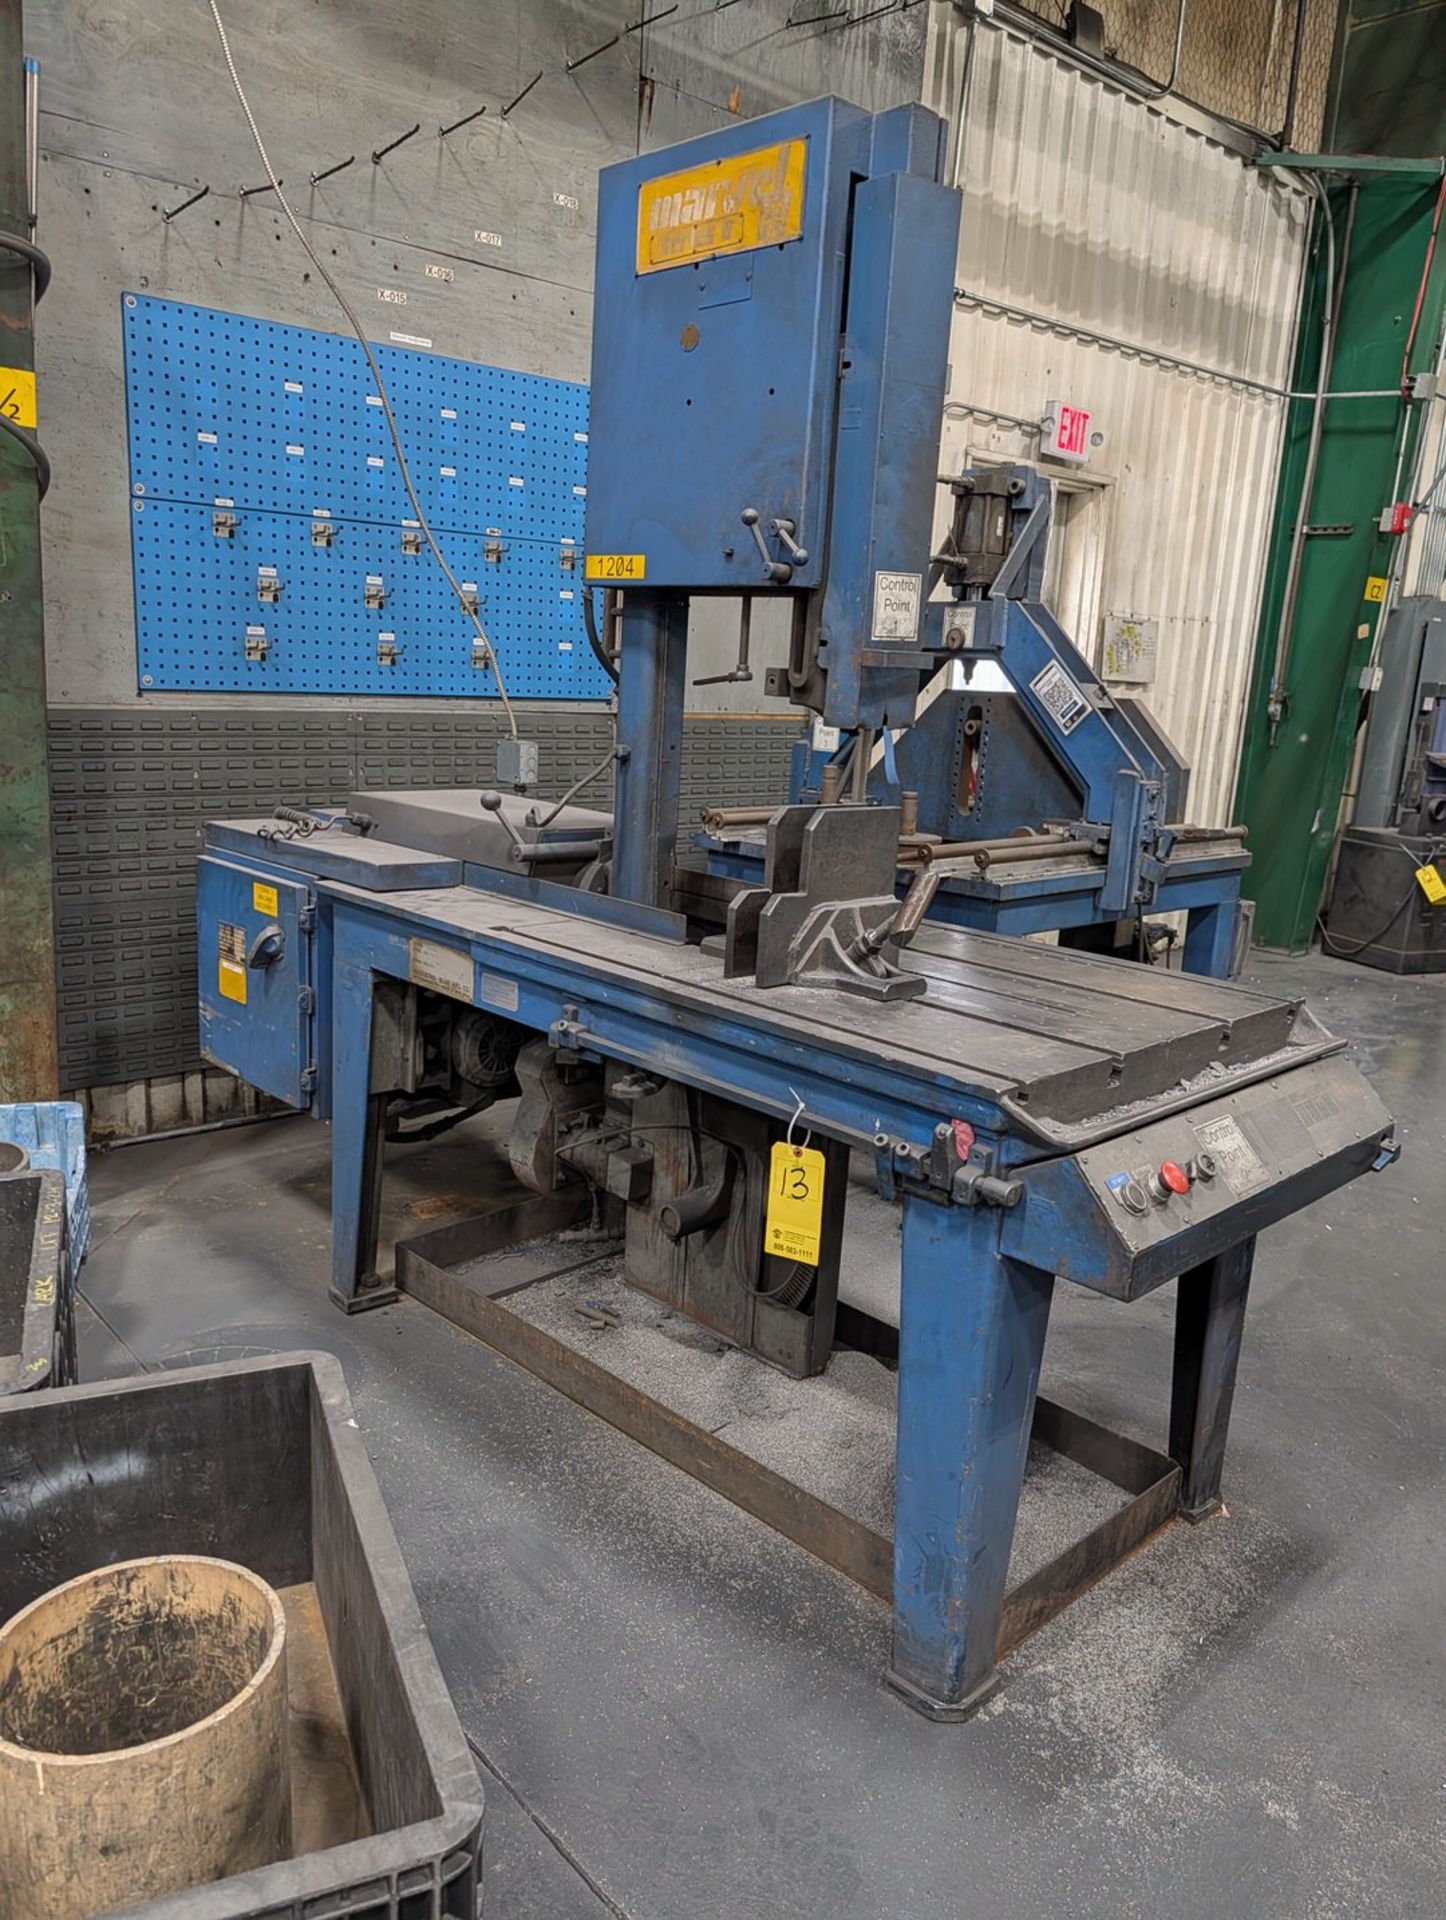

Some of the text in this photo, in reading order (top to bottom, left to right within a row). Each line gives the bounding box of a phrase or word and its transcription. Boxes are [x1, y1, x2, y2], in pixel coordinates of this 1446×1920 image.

[475, 230, 501, 246] X-017
[379, 289, 406, 304] X-015
[1057, 407, 1089, 454] EXIT
[598, 556, 635, 576] 1204
[880, 577, 917, 592] Control
[884, 598, 911, 613] Point
[780, 1167, 809, 1199] 13
